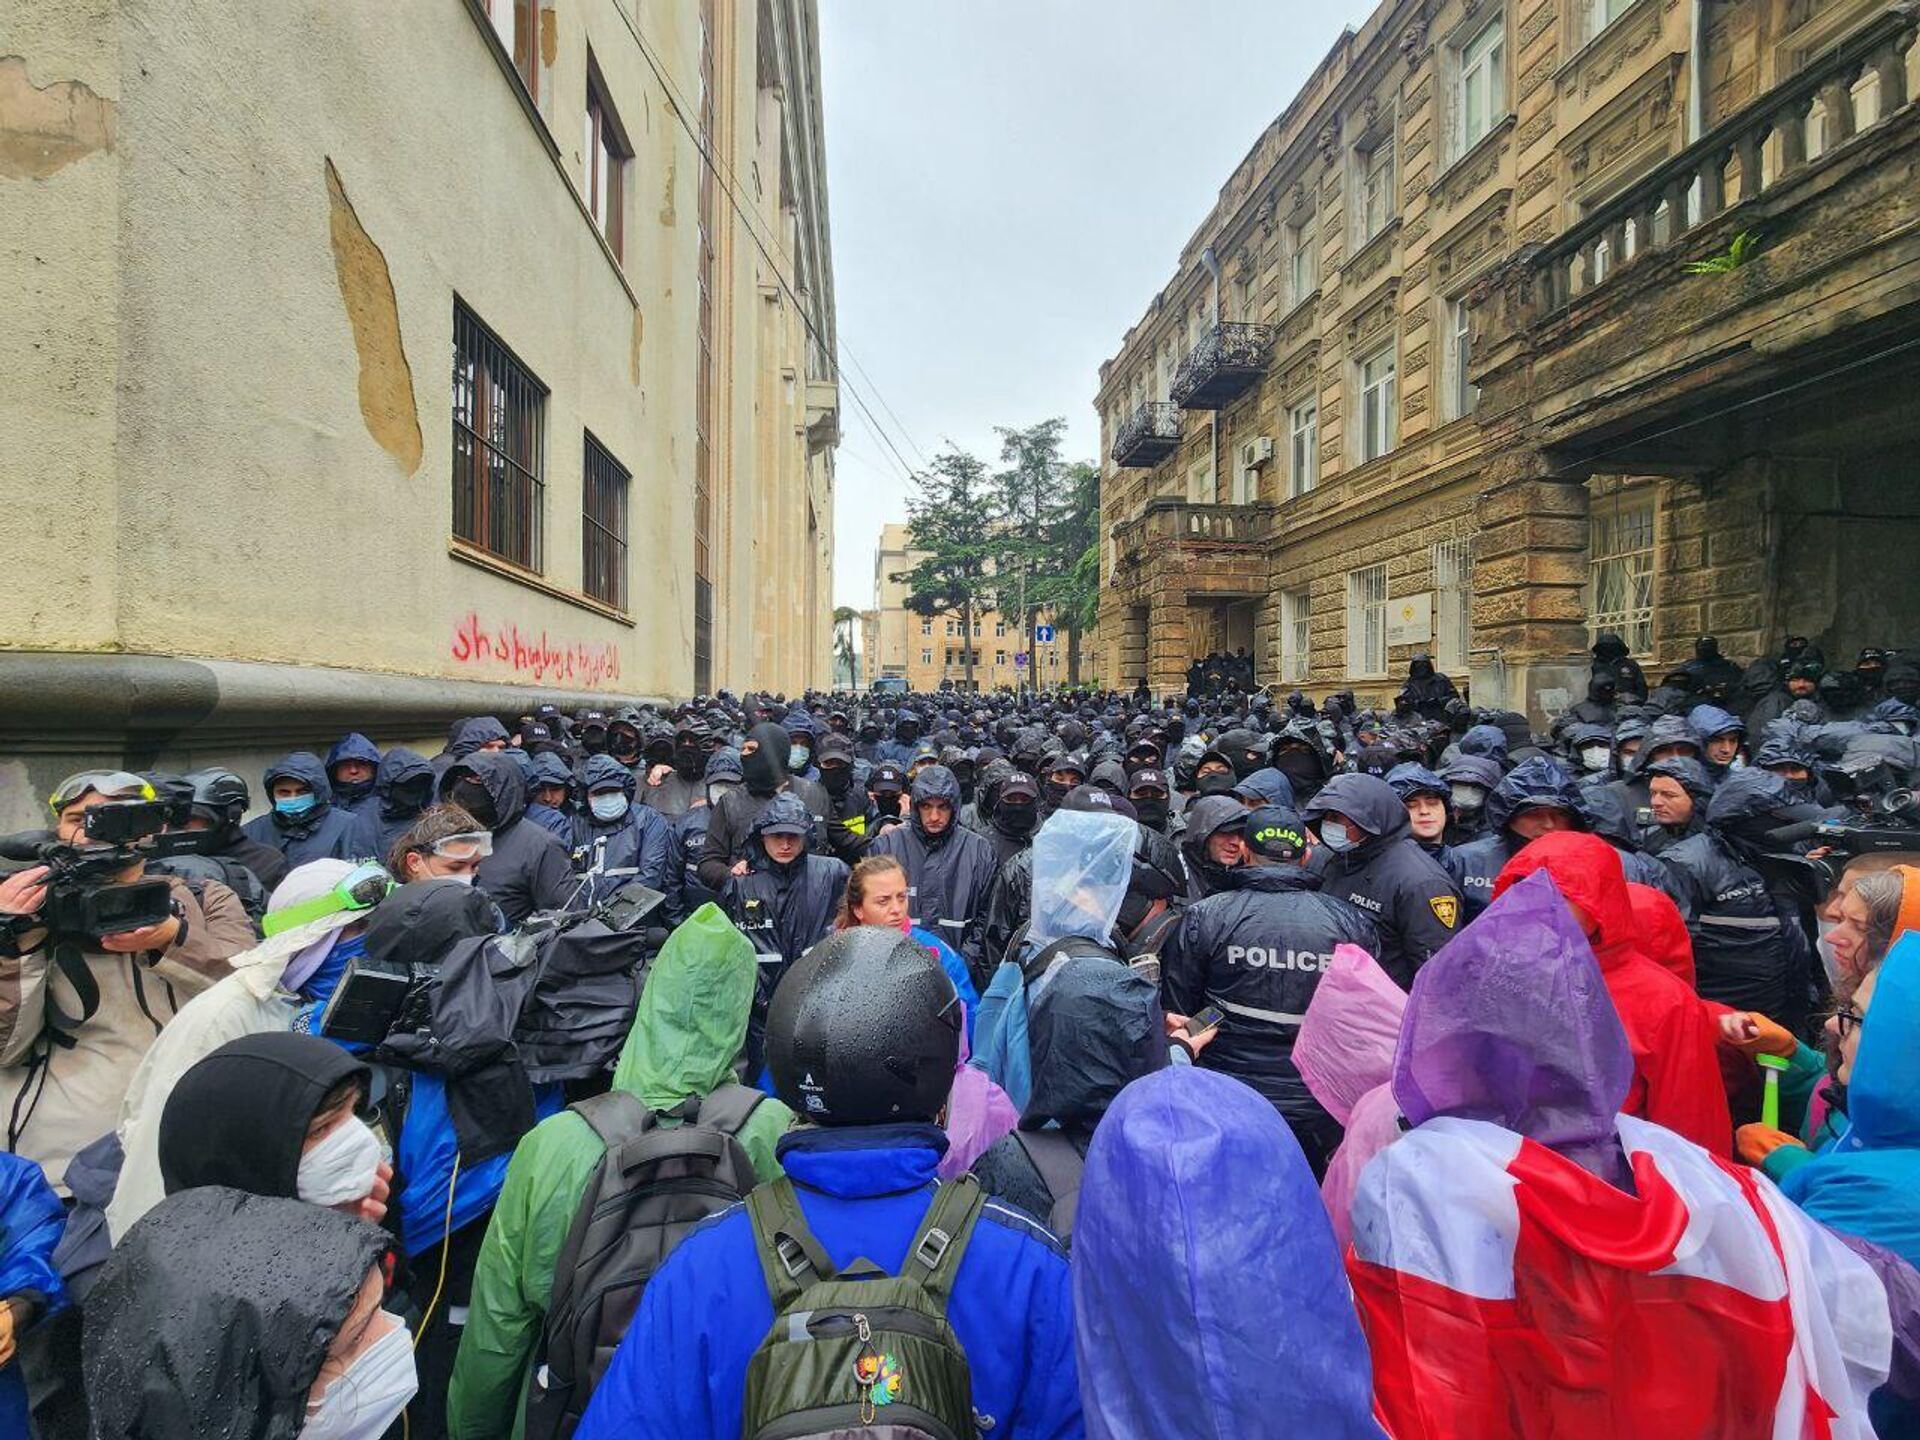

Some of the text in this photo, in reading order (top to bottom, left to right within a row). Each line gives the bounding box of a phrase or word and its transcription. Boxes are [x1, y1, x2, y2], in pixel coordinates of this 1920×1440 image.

[1256, 826, 1304, 848] POLICE
[1348, 892, 1382, 913] POLICE
[1227, 944, 1333, 972] POLICE
